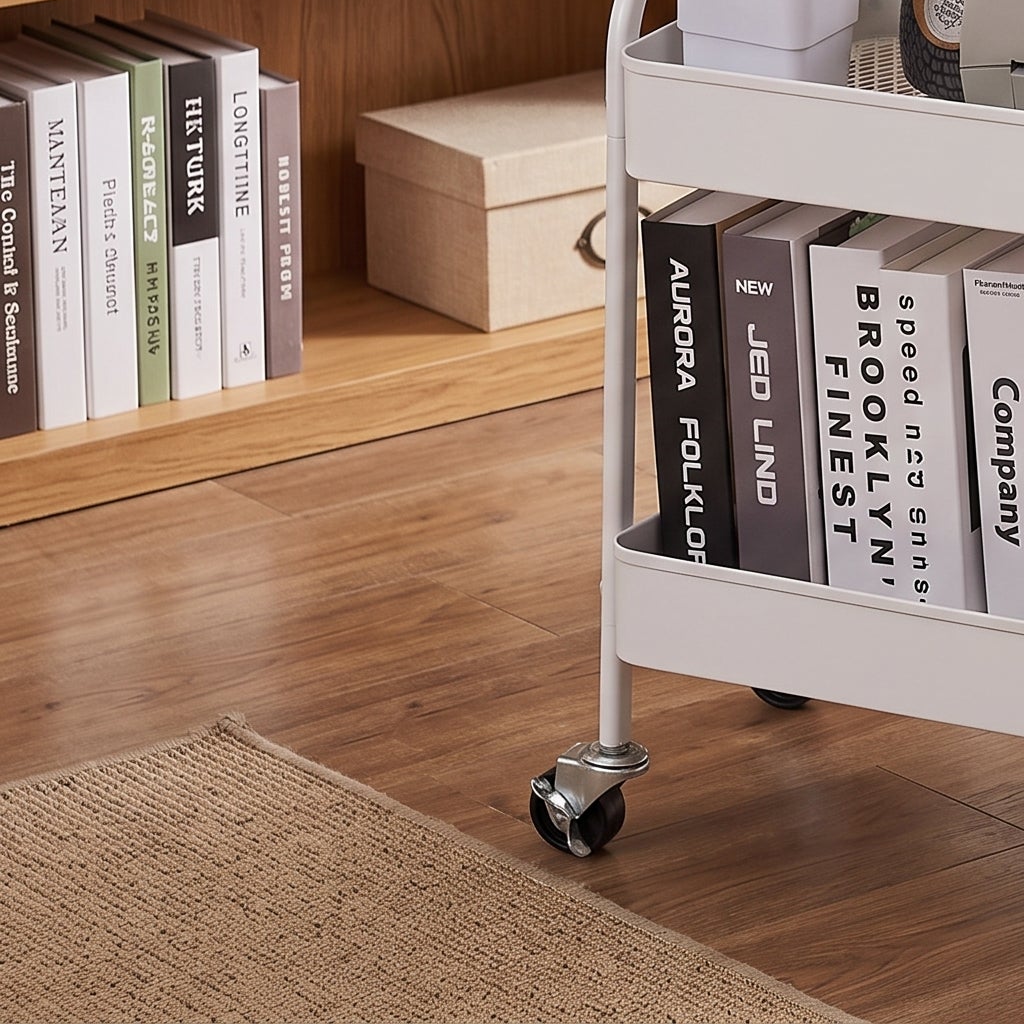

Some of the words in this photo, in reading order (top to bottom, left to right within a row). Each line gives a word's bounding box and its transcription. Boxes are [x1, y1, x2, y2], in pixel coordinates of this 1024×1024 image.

[669, 256, 698, 392] AURORA
[735, 278, 774, 297] NEW
[747, 322, 772, 402] JED
[896, 294, 924, 407] speed
[752, 418, 778, 507] LIND
[824, 354, 859, 544] FINEST
[991, 376, 1021, 548] Company
